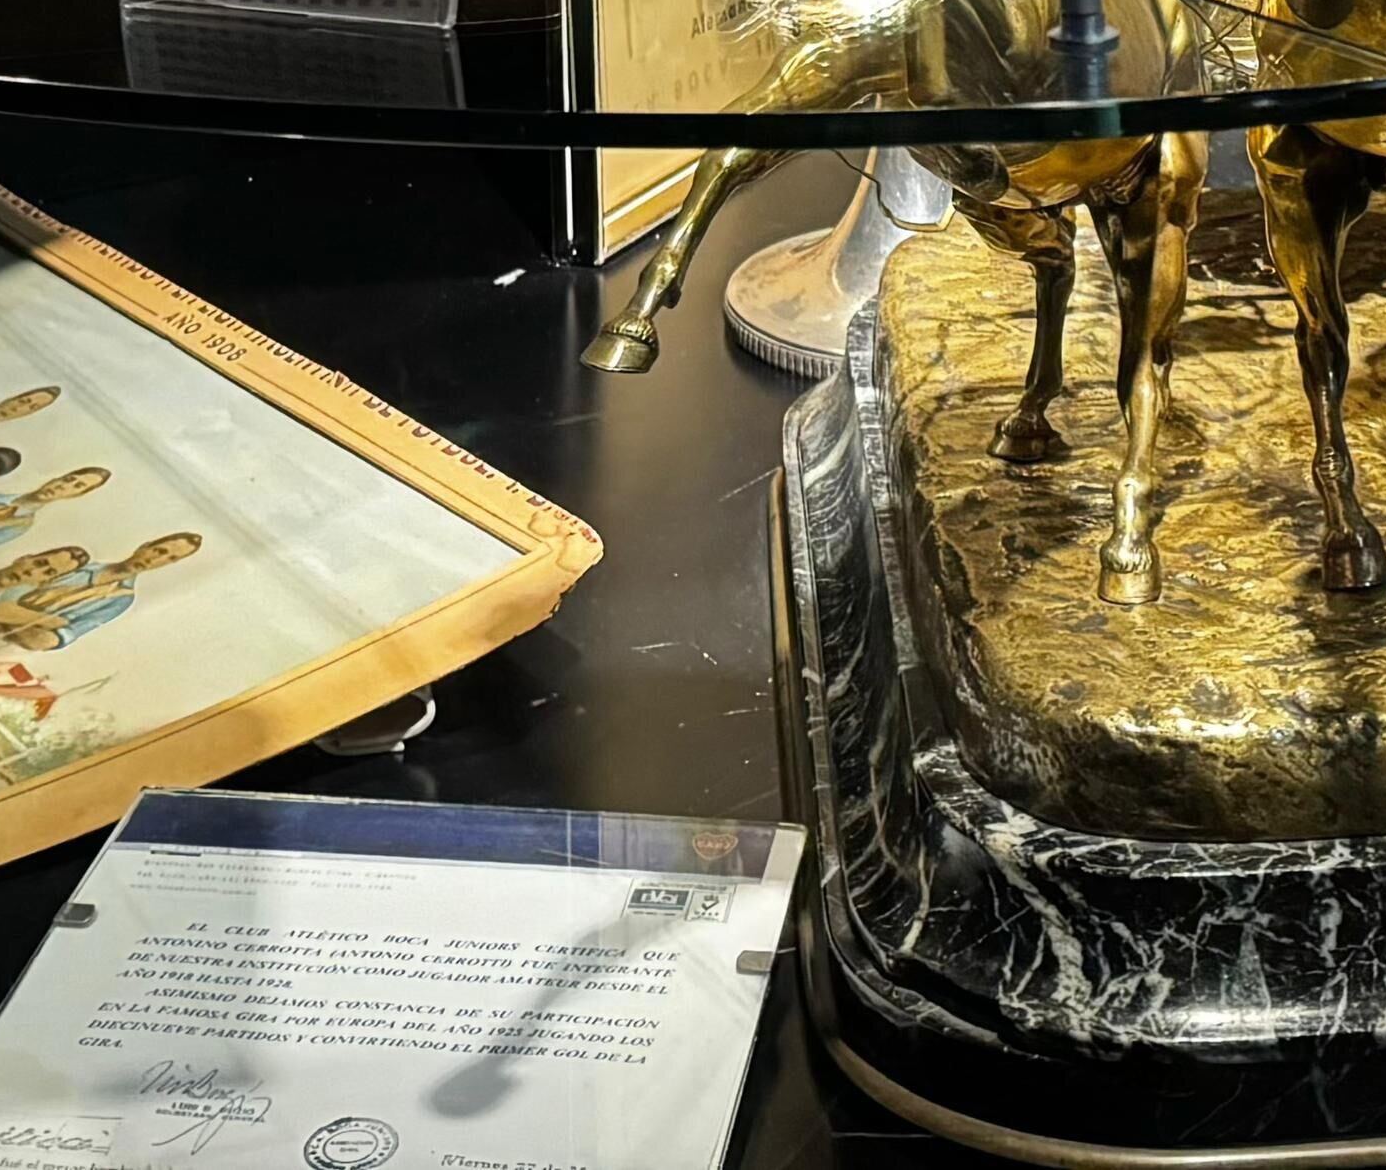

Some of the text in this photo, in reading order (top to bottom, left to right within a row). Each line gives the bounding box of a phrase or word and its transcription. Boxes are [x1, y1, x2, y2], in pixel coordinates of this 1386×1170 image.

[163, 310, 249, 363] AÑO 1908
[136, 936, 229, 950] ANTONINO
[233, 942, 322, 958] CERROTTA
[521, 959, 559, 971] FUE
[562, 962, 677, 979] INTEGRANTE
[186, 922, 682, 962] EL CLUB ATLÉTICO BOCA JUNIORS CERTIFICA QUE
[115, 967, 157, 979] AÑO
[196, 974, 253, 987] HASTA
[126, 952, 669, 995] DE NUESTRA INSTITUCIÓN COMO JUGADOR AMATEUR DESDE EL
[97, 1002, 656, 1047] EN LA FAMOSA GIRA POR EUROPA DEL AÑO 1925 JUGANDO LOS
[144, 988, 661, 1030] ASIMISMO DEJAMOS CONSTANCIA DE SU PARTICIPACIÓN
[87, 1019, 647, 1064] DIECINUEVE PARTIDOS Y CONVIRTIENDO EL PRIMER GOL DE LA
